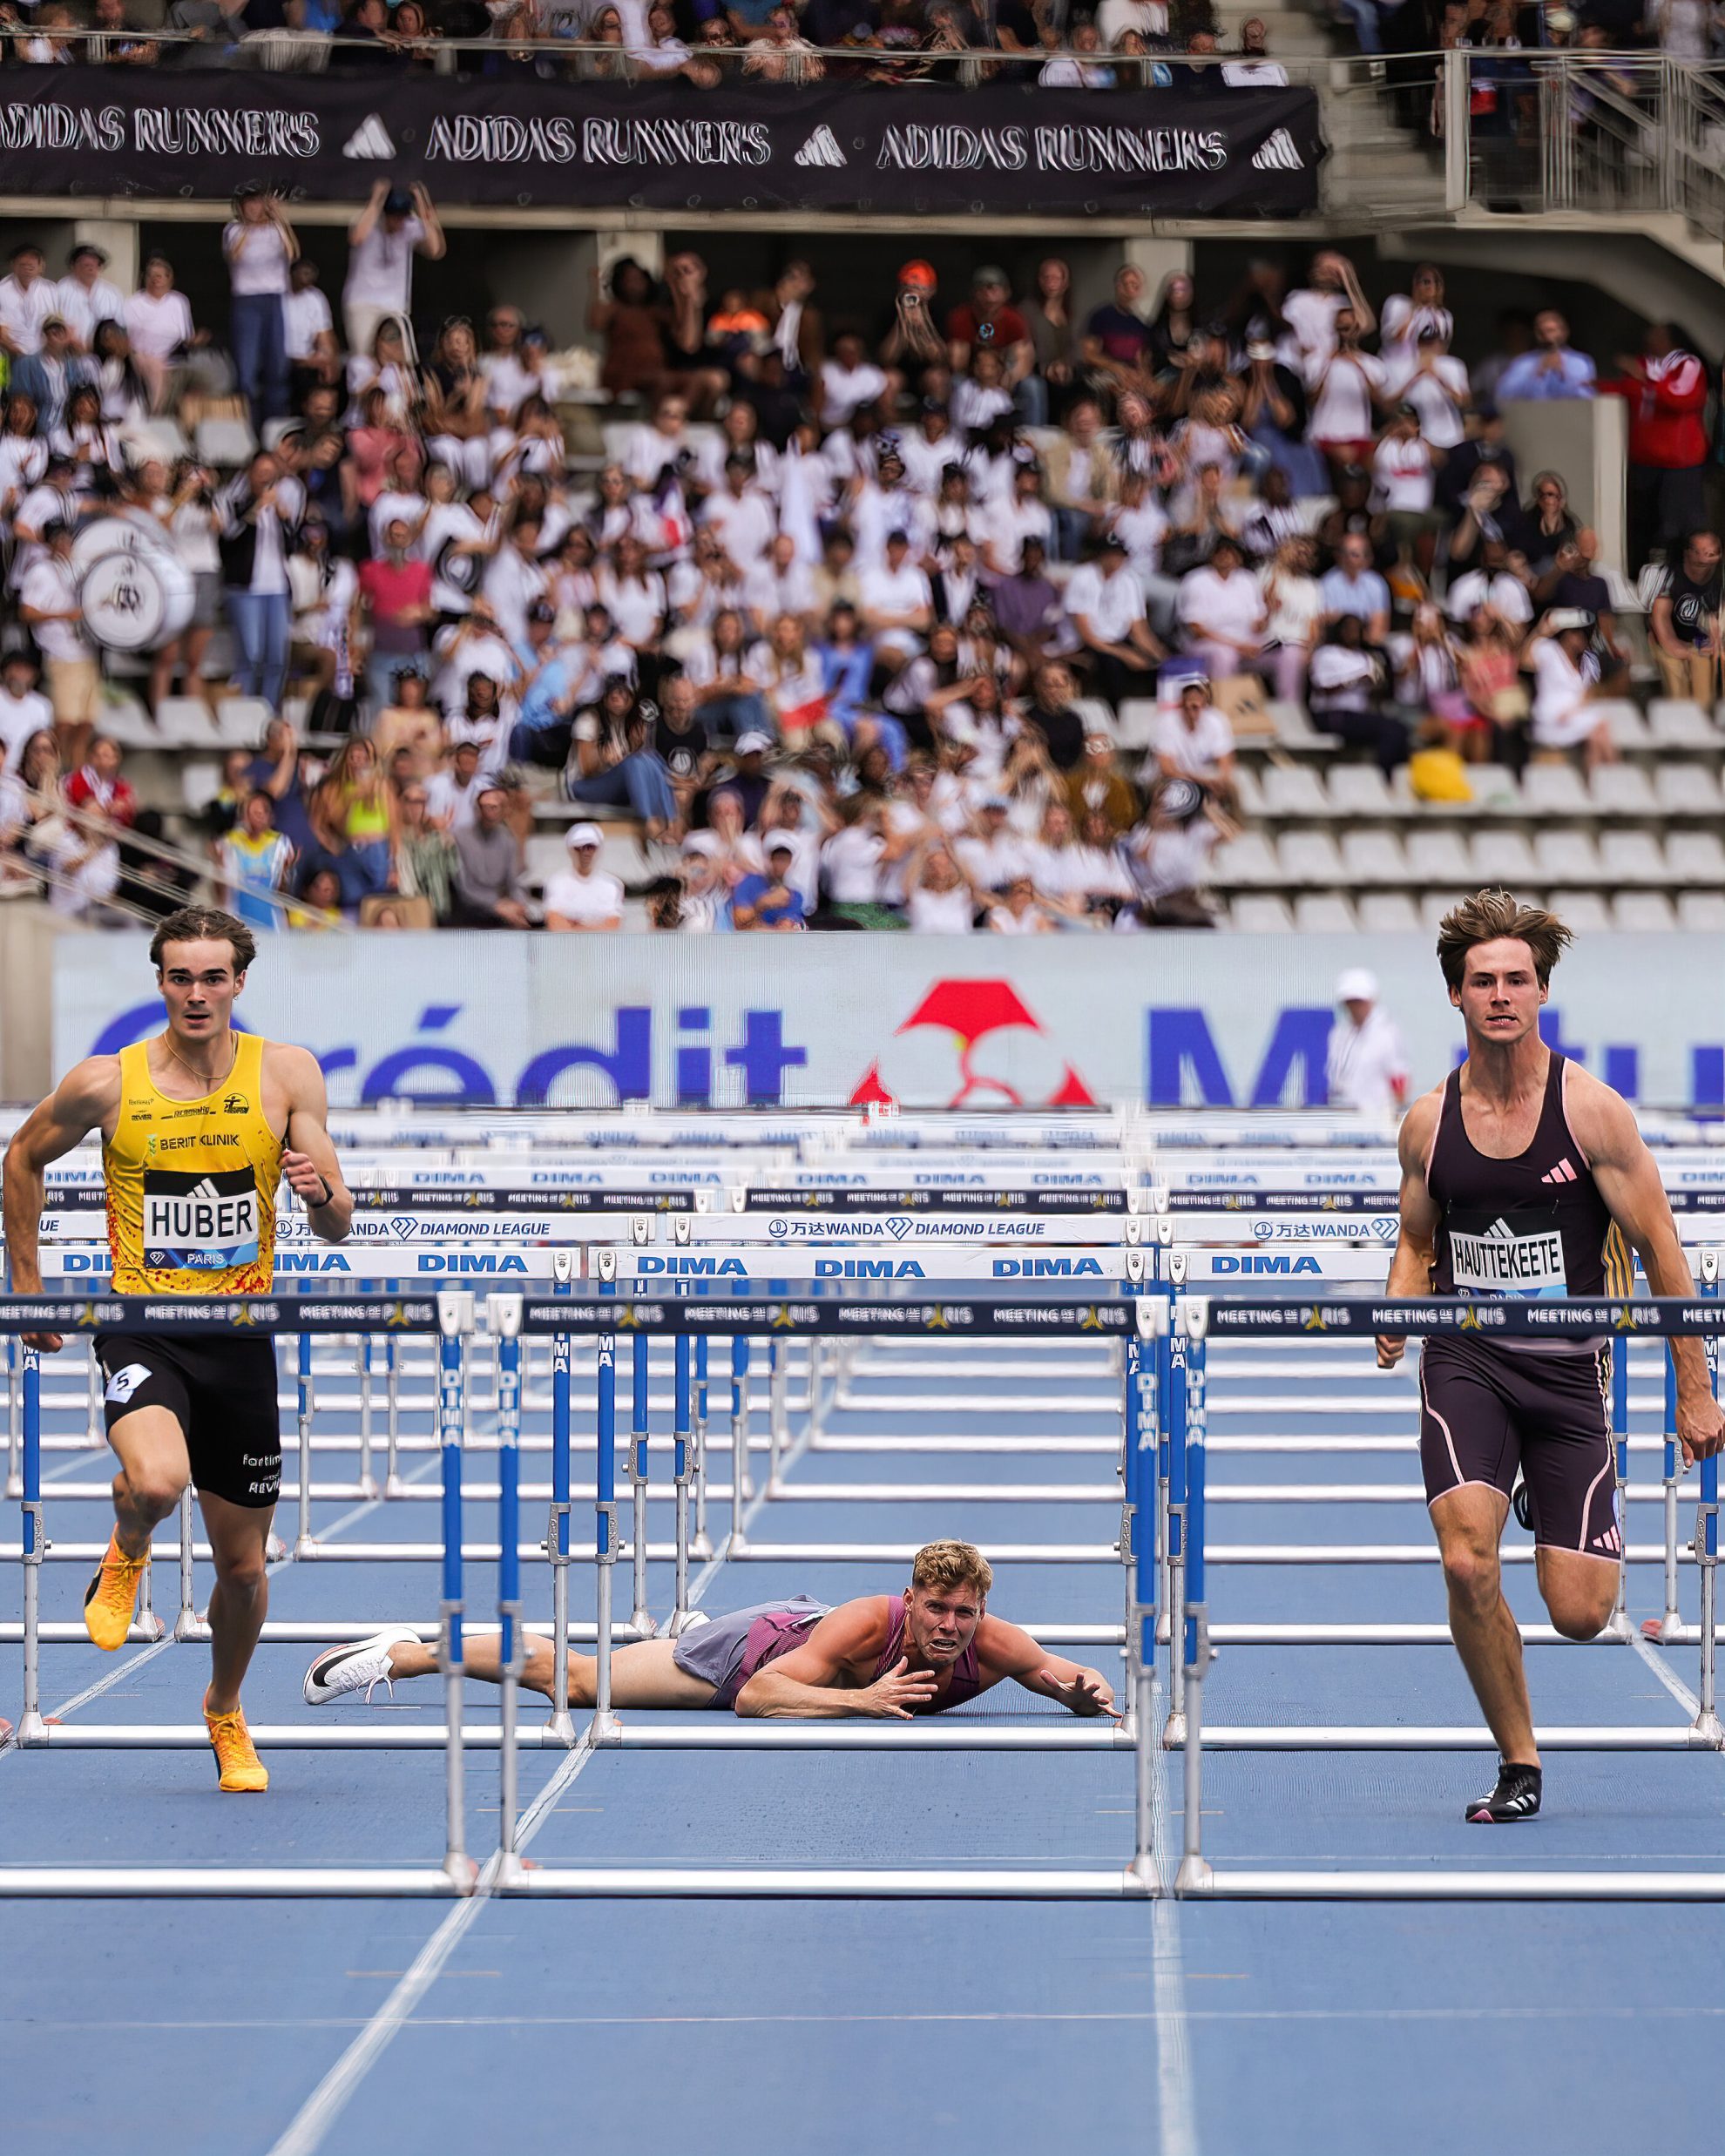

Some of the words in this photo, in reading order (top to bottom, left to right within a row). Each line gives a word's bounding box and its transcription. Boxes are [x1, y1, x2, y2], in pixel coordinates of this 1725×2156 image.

[424, 114, 577, 163] ADIDAS
[583, 117, 772, 166] RUNNERS
[876, 124, 1030, 171] ADIDAS
[160, 1136, 196, 1151] BERIT
[1363, 1195, 1400, 1206] MEETIN
[152, 1200, 253, 1238] HUBER
[348, 1223, 389, 1235] ANDA
[420, 1223, 490, 1235] DIAMOND
[493, 1223, 551, 1235] LEAGUE
[790, 1222, 825, 1235] 万达
[826, 1223, 884, 1235] WANDA
[915, 1223, 984, 1235] DIAMOND
[988, 1223, 1045, 1235] LEAGUE
[1275, 1224, 1310, 1238] 万达
[1311, 1225, 1370, 1237] WANDA
[63, 1254, 112, 1272] DI
[187, 1253, 225, 1265] PARIS
[274, 1254, 352, 1272] IMA
[417, 1254, 529, 1273] DIMA
[637, 1256, 748, 1275] DIMA
[992, 1258, 1104, 1277] DIMA
[1211, 1256, 1322, 1274] DIMA
[1453, 1238, 1561, 1279] HAUTTEKEETE
[815, 1259, 926, 1278] DIMA
[993, 1308, 1060, 1322] MEETING
[1217, 1308, 1283, 1323] MEETING
[1372, 1308, 1438, 1323] MEETING
[1527, 1308, 1593, 1323] MEETING
[1682, 1308, 1725, 1323] MEETI
[117, 1373, 130, 1392] 5
[442, 1369, 462, 1447] DIMA
[499, 1369, 518, 1449] DIMA
[1136, 1372, 1158, 1451] DIMA
[1186, 1369, 1207, 1448] DIMA
